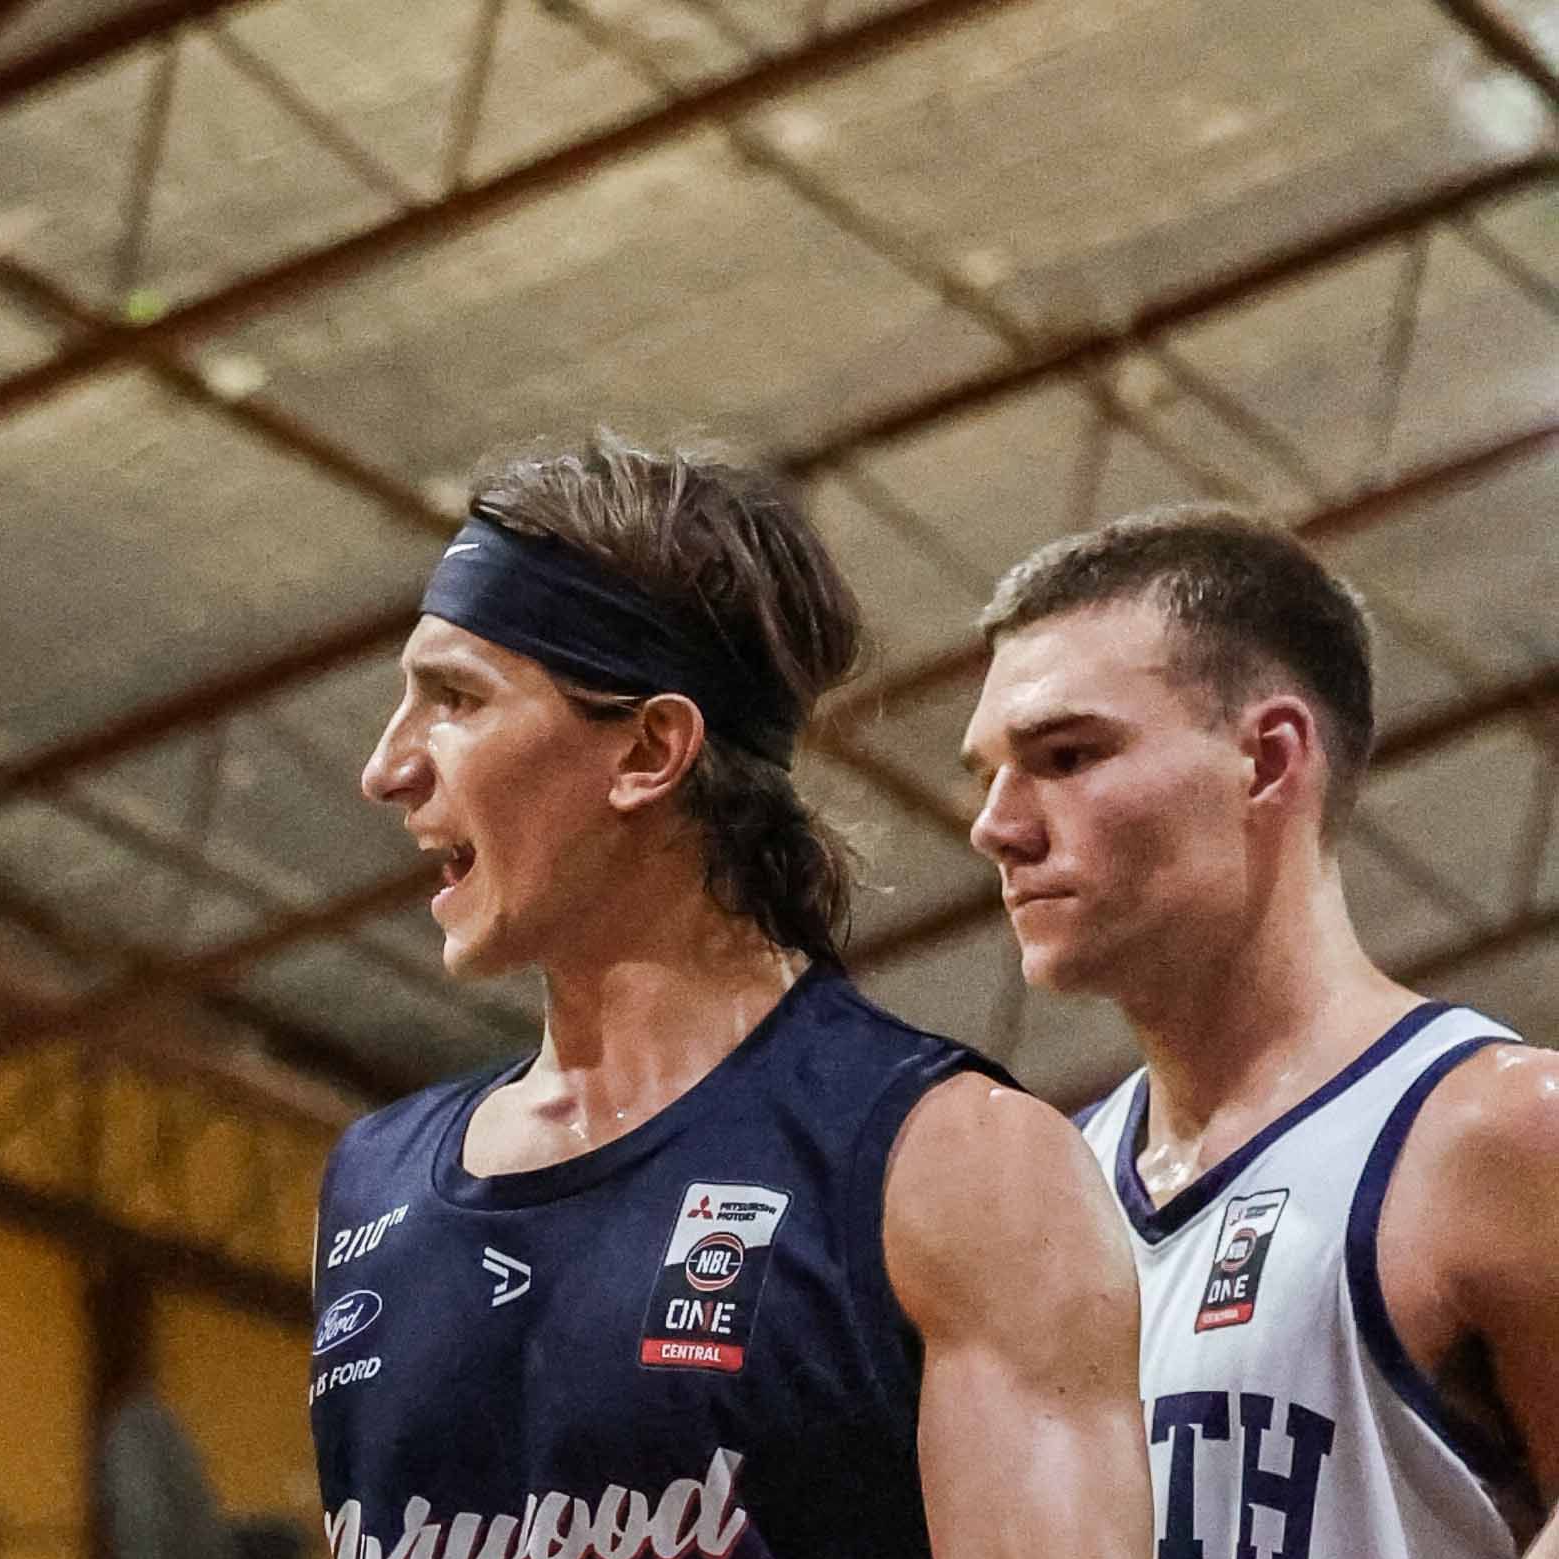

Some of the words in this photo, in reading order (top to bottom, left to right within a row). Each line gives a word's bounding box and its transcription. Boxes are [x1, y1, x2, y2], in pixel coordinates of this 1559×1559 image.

[696, 1250, 732, 1276] NBL
[1207, 1274, 1249, 1303] ONE
[316, 1299, 365, 1348] Ford
[665, 1299, 736, 1334] ONE
[661, 1343, 722, 1362] CENTRAL
[329, 1356, 382, 1389] FORD
